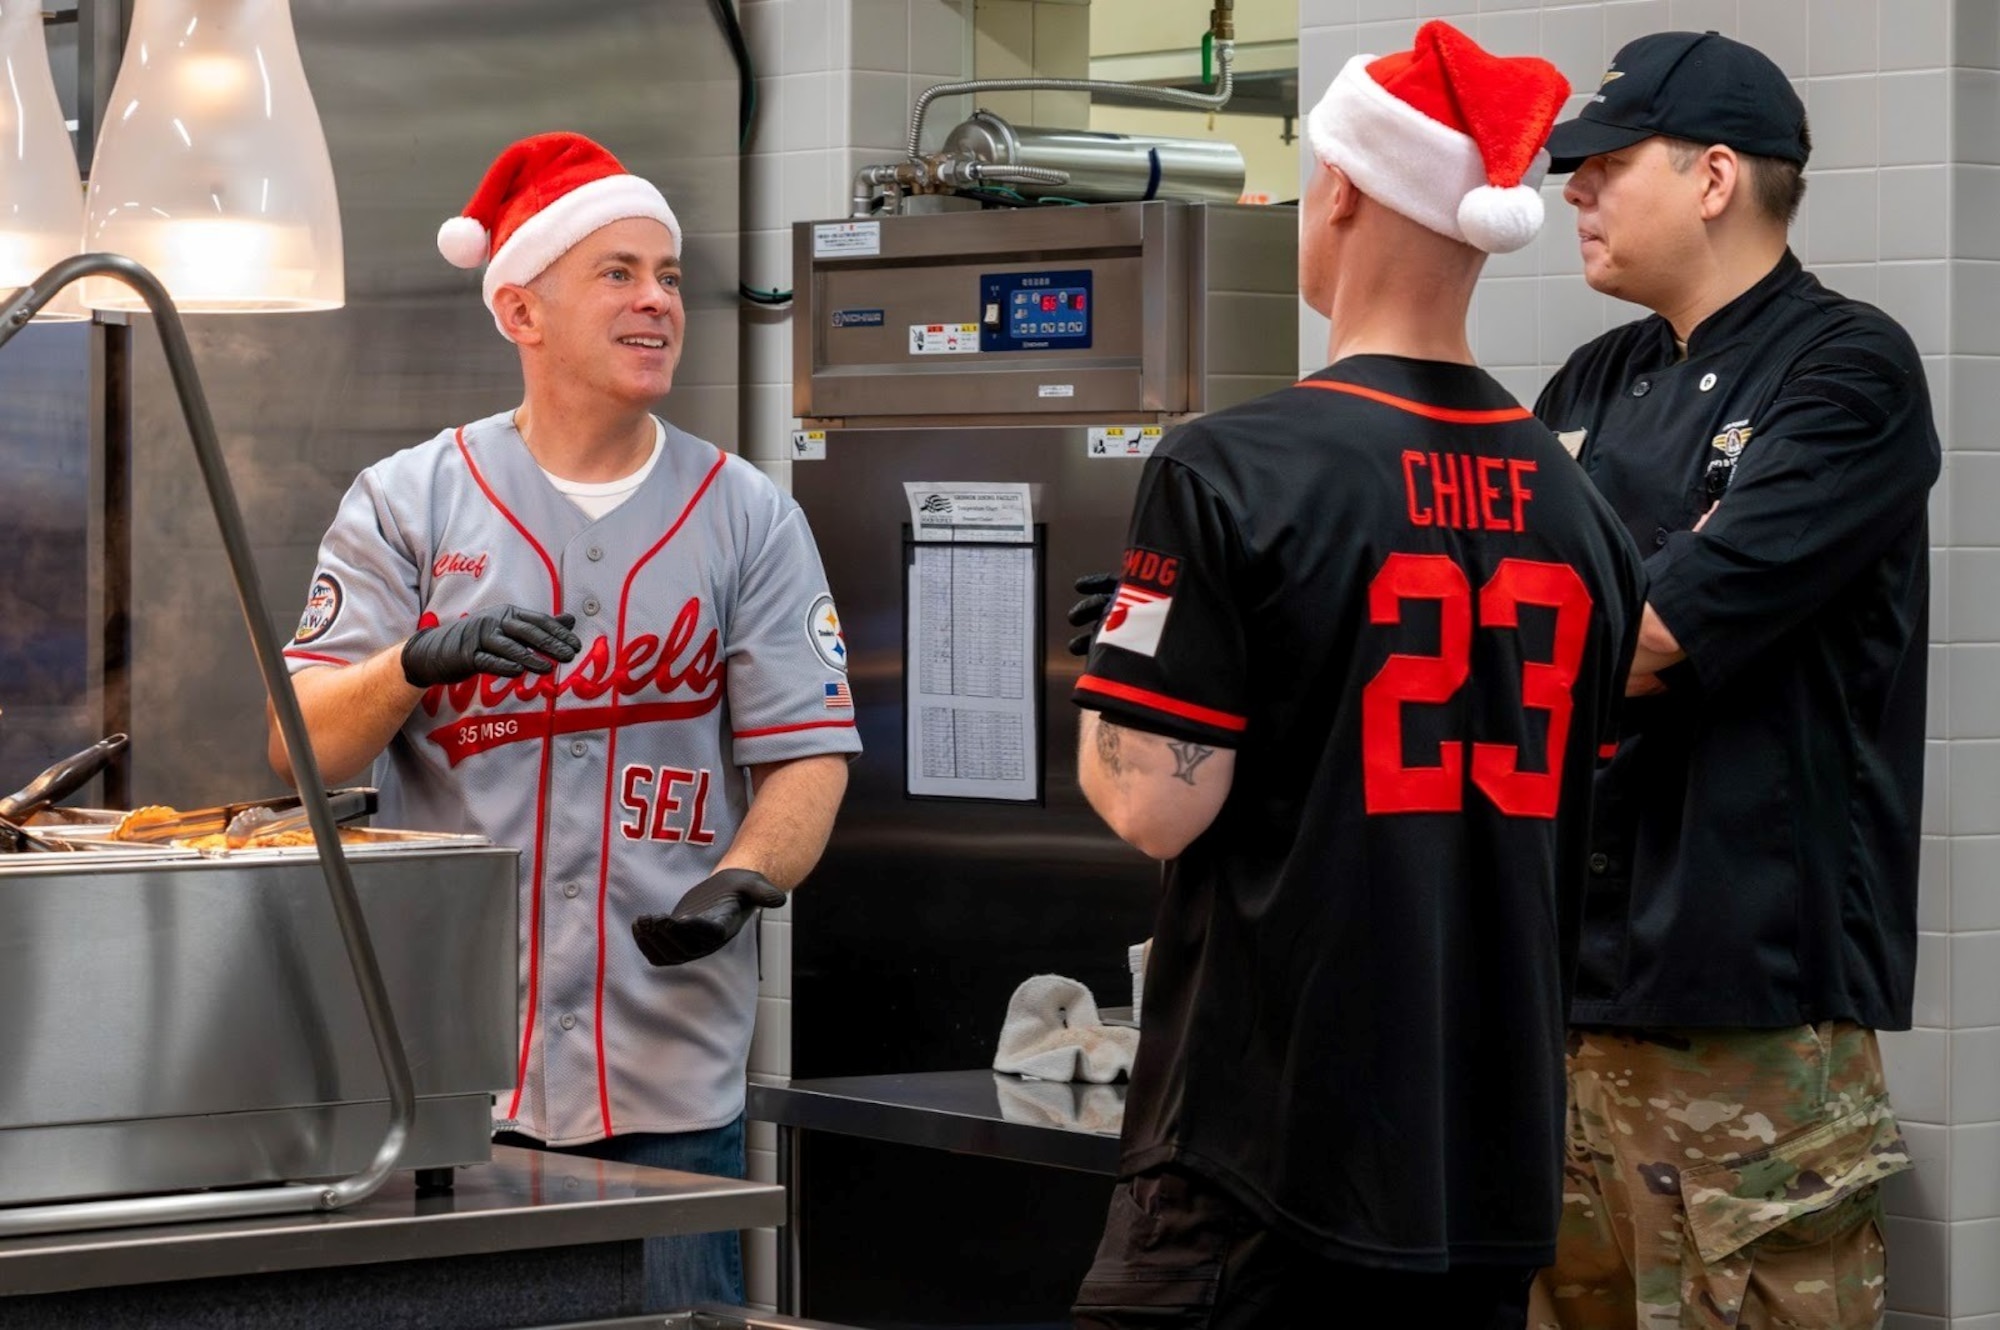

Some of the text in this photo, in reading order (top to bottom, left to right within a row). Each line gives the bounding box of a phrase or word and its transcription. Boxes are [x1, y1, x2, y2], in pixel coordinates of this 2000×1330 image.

[1401, 449, 1538, 532] CHIEF
[433, 552, 488, 579] Chief
[1361, 552, 1593, 819] 23
[458, 719, 519, 746] 35 MSG
[620, 764, 716, 846] SEL
